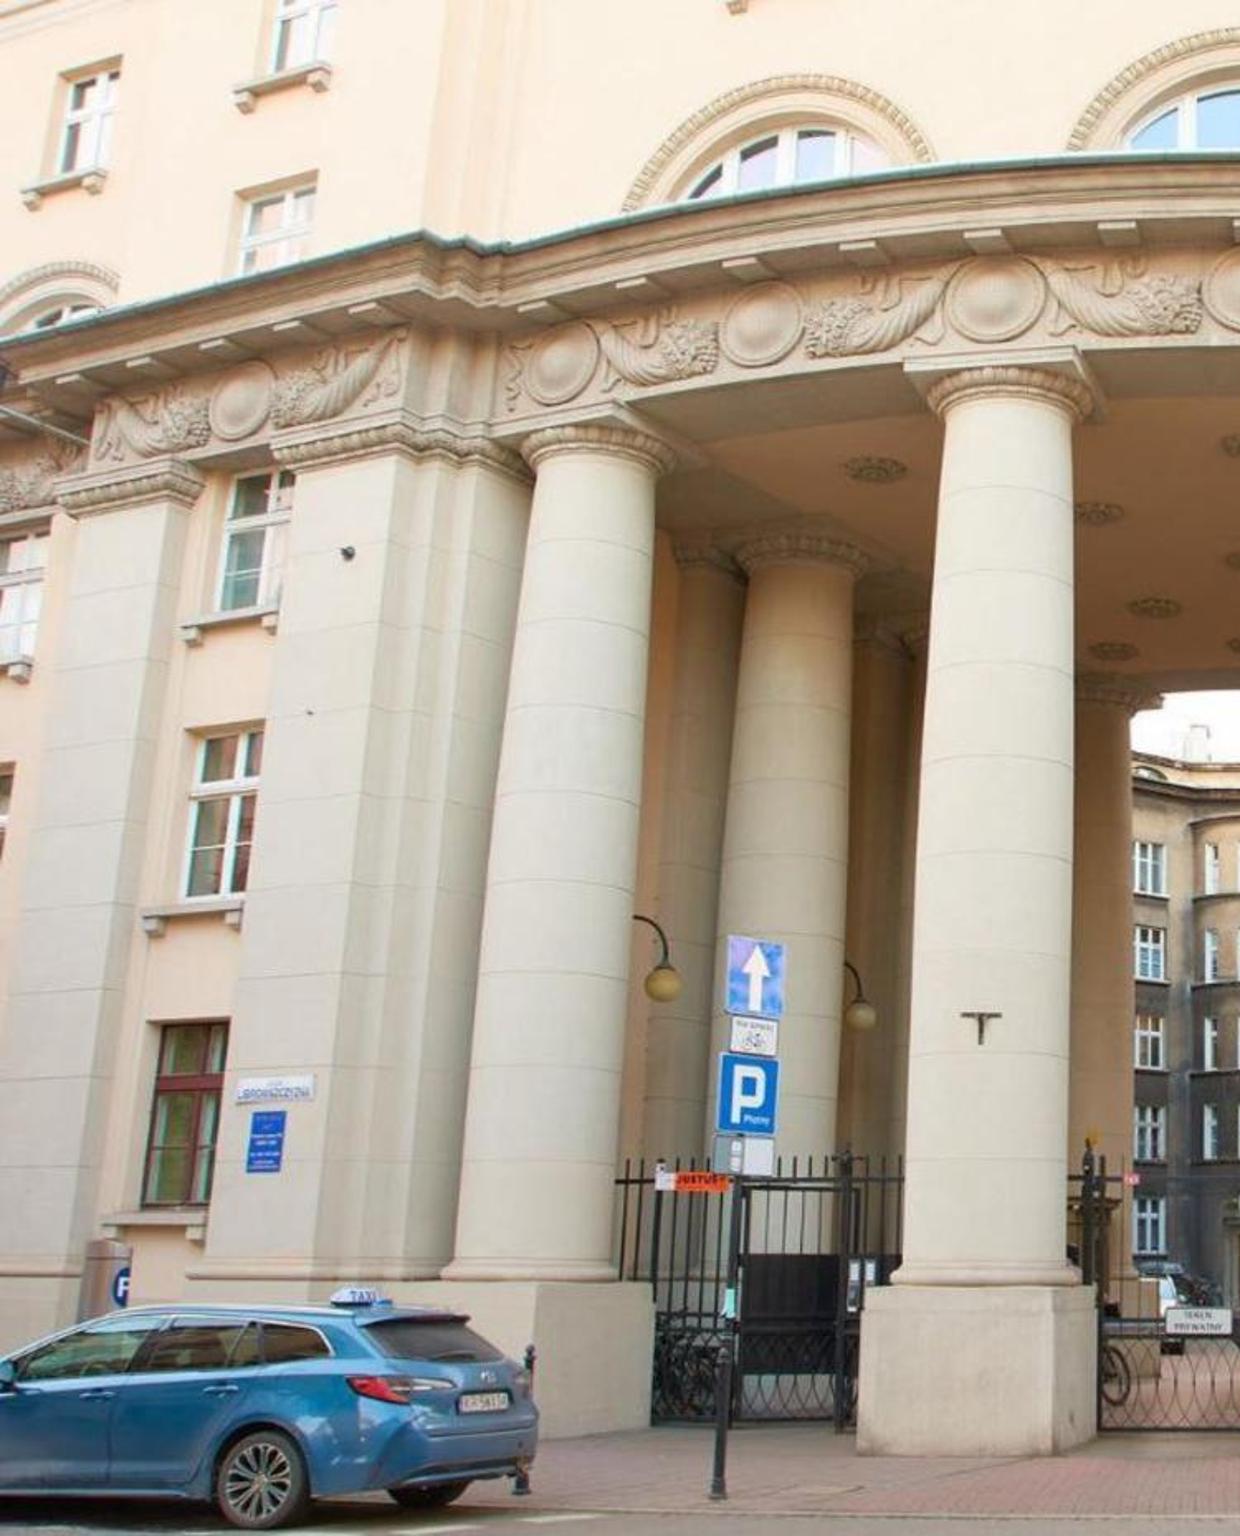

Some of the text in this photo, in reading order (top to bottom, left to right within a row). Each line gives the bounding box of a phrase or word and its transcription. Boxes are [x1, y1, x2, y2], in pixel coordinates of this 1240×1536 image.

[730, 1064, 767, 1125] P
[349, 1290, 377, 1303] TAXI
[1184, 1310, 1213, 1319] TEREN
[1174, 1322, 1223, 1331] PRYWATNY
